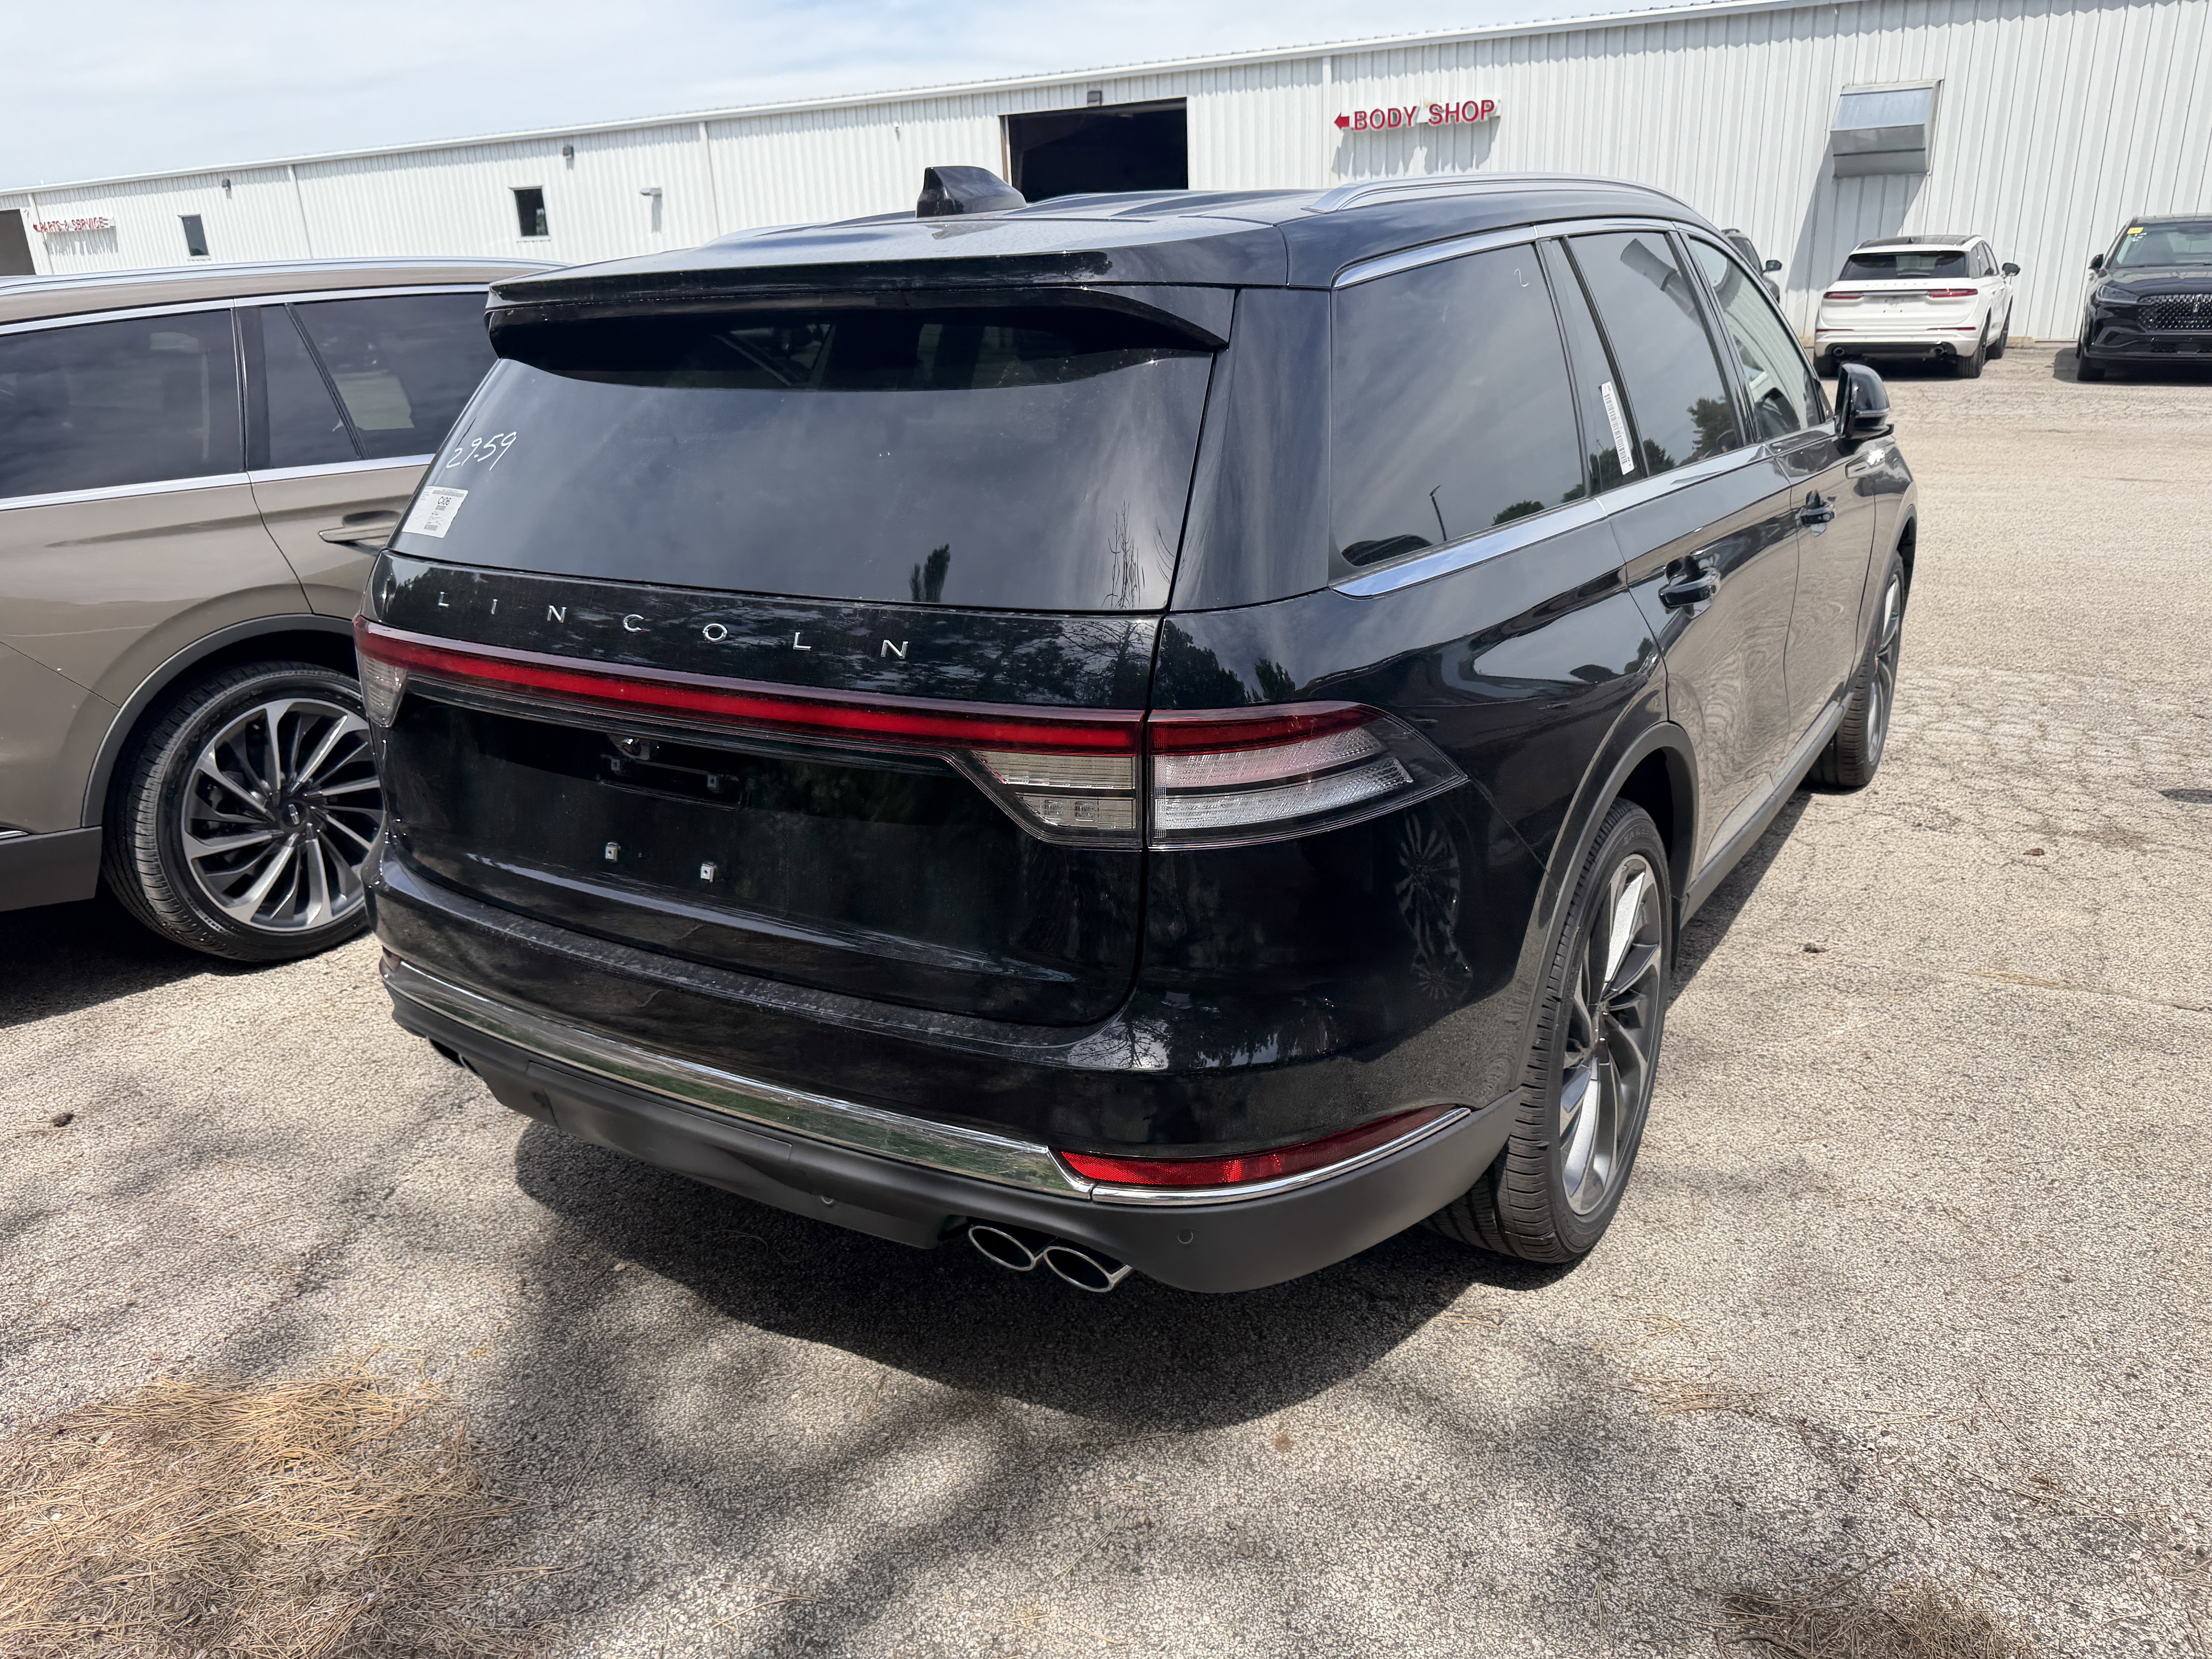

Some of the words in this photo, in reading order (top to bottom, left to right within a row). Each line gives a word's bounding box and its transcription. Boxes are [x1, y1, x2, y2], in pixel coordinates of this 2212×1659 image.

[1354, 106, 1418, 131] BODY
[1428, 99, 1496, 126] SHOP
[39, 220, 62, 233] PARTS
[72, 217, 105, 231] SERVICE
[438, 591, 909, 659] LINCOLN
